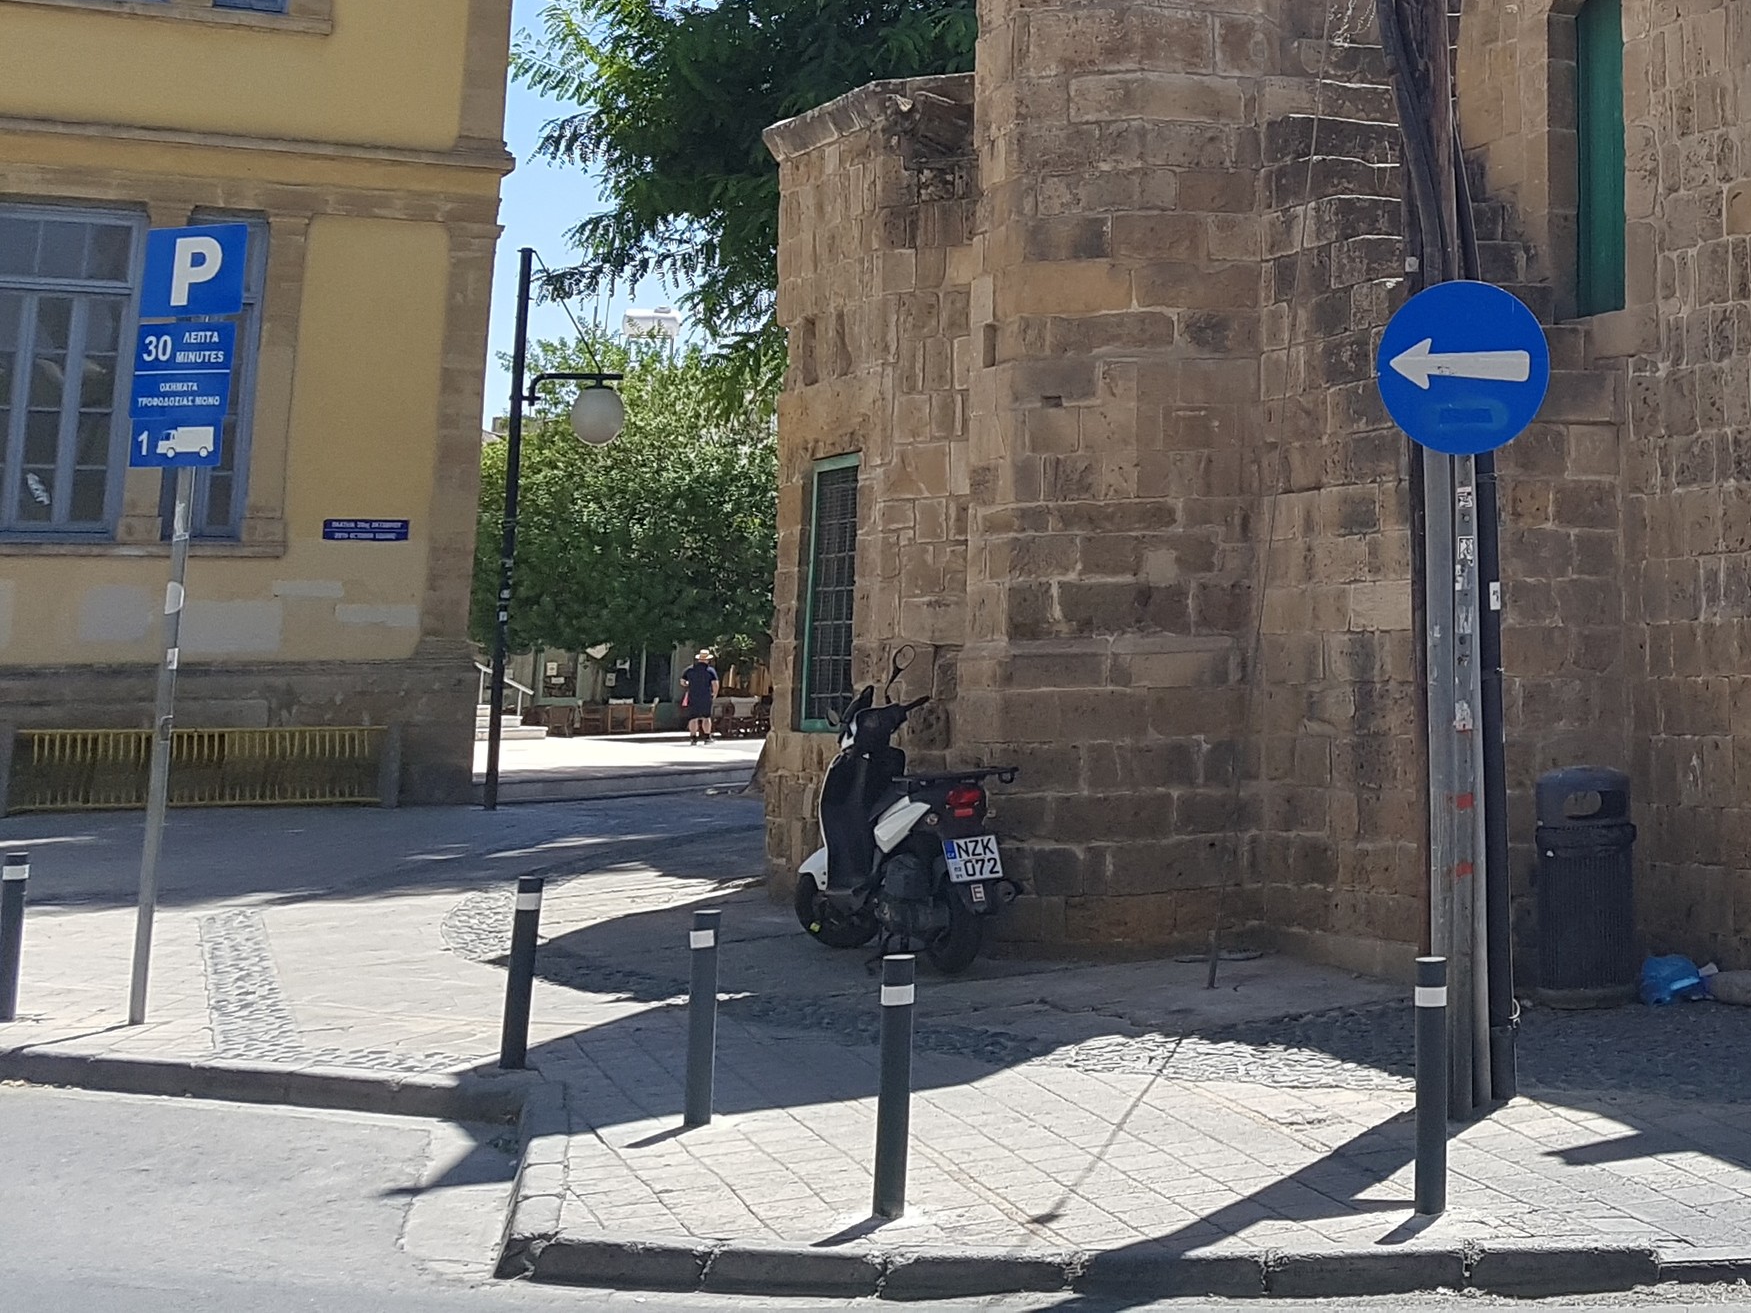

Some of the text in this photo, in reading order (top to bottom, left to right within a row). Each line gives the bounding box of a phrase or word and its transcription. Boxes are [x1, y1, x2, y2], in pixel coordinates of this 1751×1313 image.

[169, 236, 223, 307] P
[182, 331, 219, 343] ΛΕΠΤΑ
[142, 334, 172, 362] 30
[175, 351, 224, 363] MINUTES
[194, 396, 220, 406] ΜΟΝΟ
[137, 430, 149, 456] 1
[956, 838, 994, 858] NZK
[964, 858, 999, 876] 072
[973, 886, 983, 899] E
